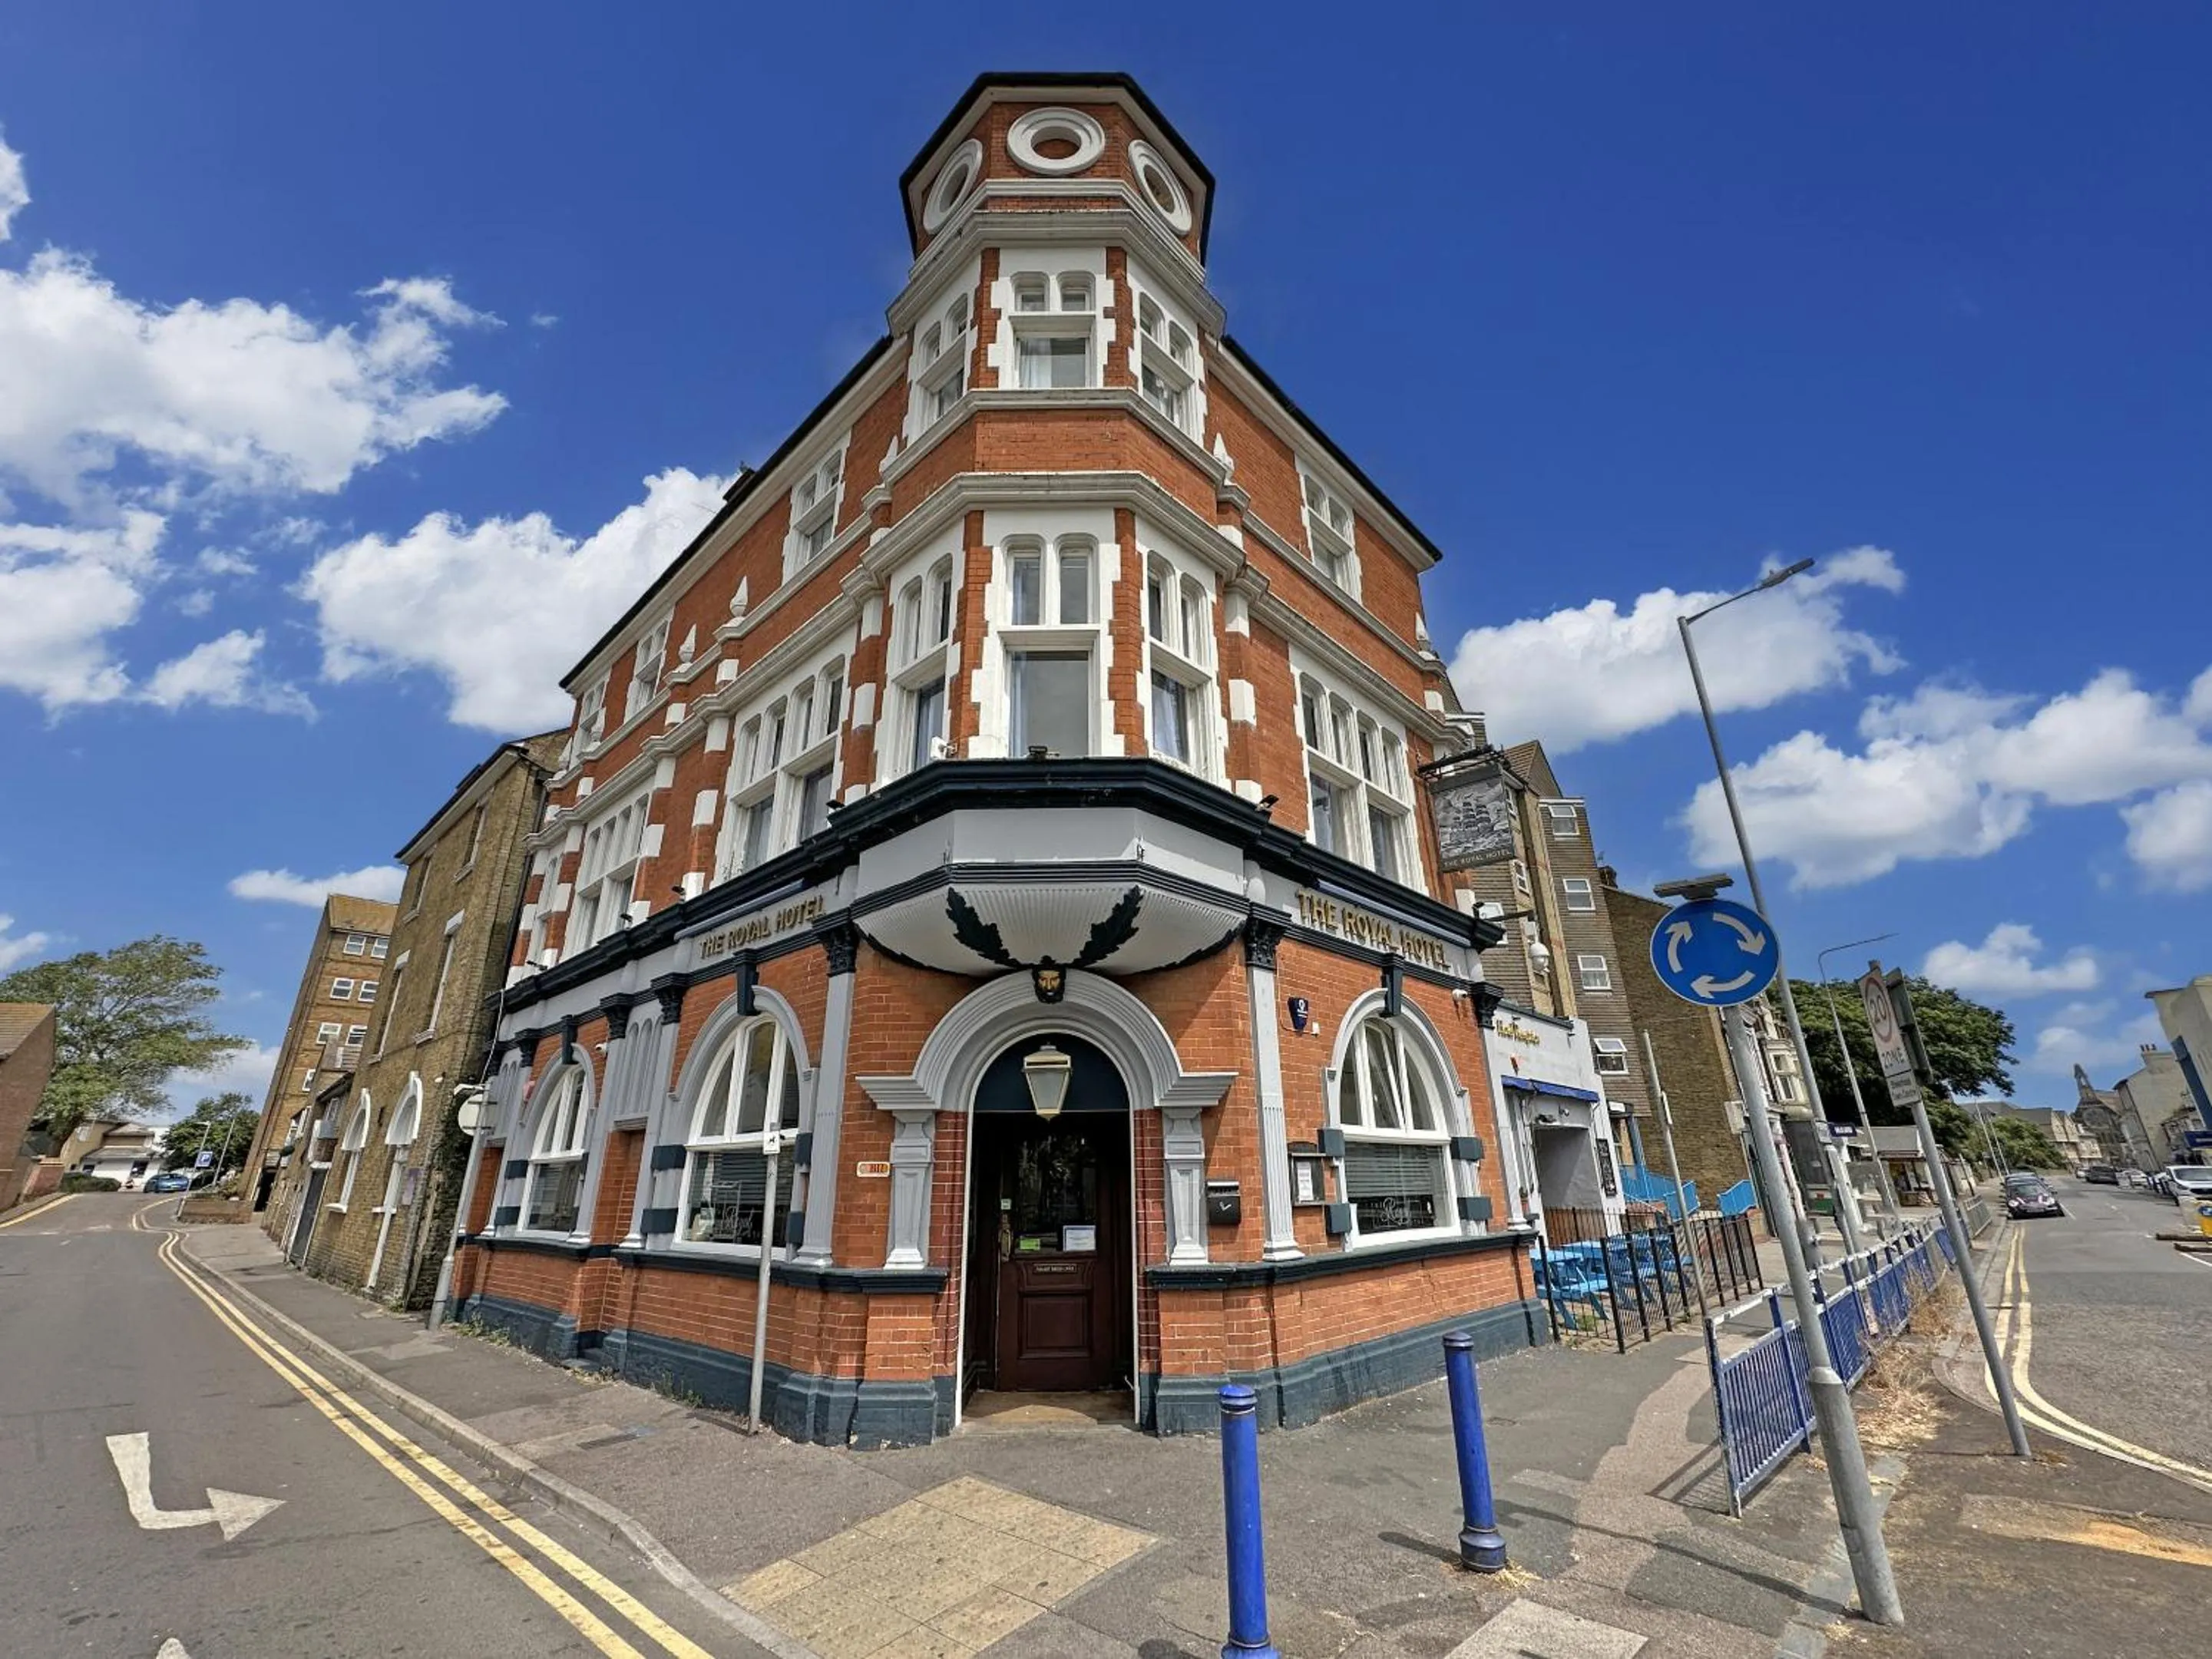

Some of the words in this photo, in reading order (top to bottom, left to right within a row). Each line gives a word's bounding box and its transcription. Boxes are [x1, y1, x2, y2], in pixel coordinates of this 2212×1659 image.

[699, 933, 726, 959] THE
[728, 916, 772, 949] ROYAL
[775, 894, 825, 933] HOTEL
[1295, 888, 1337, 930] THE
[1342, 907, 1400, 950] ROYAL
[1400, 929, 1450, 970] HOTEL
